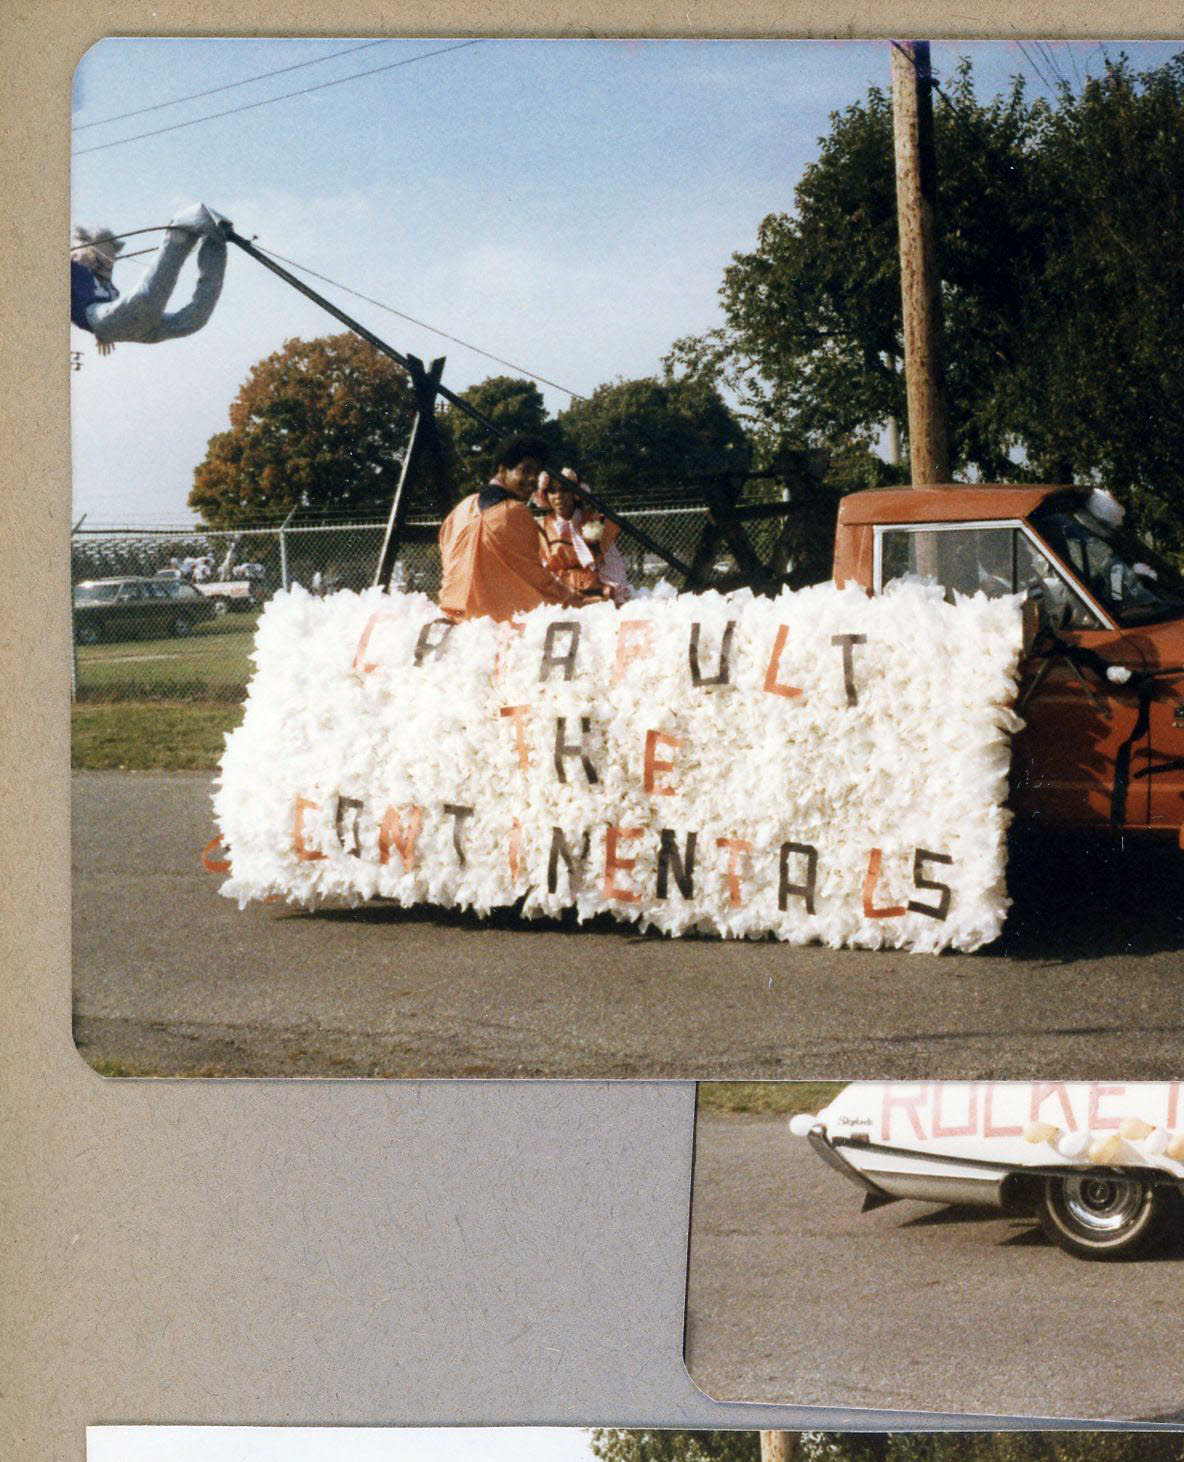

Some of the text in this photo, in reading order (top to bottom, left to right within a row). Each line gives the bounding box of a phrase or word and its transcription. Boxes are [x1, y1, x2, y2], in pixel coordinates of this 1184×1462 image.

[352, 611, 868, 707] CATAPULT
[499, 703, 686, 797] THE
[293, 794, 953, 921] CONTINENTALS
